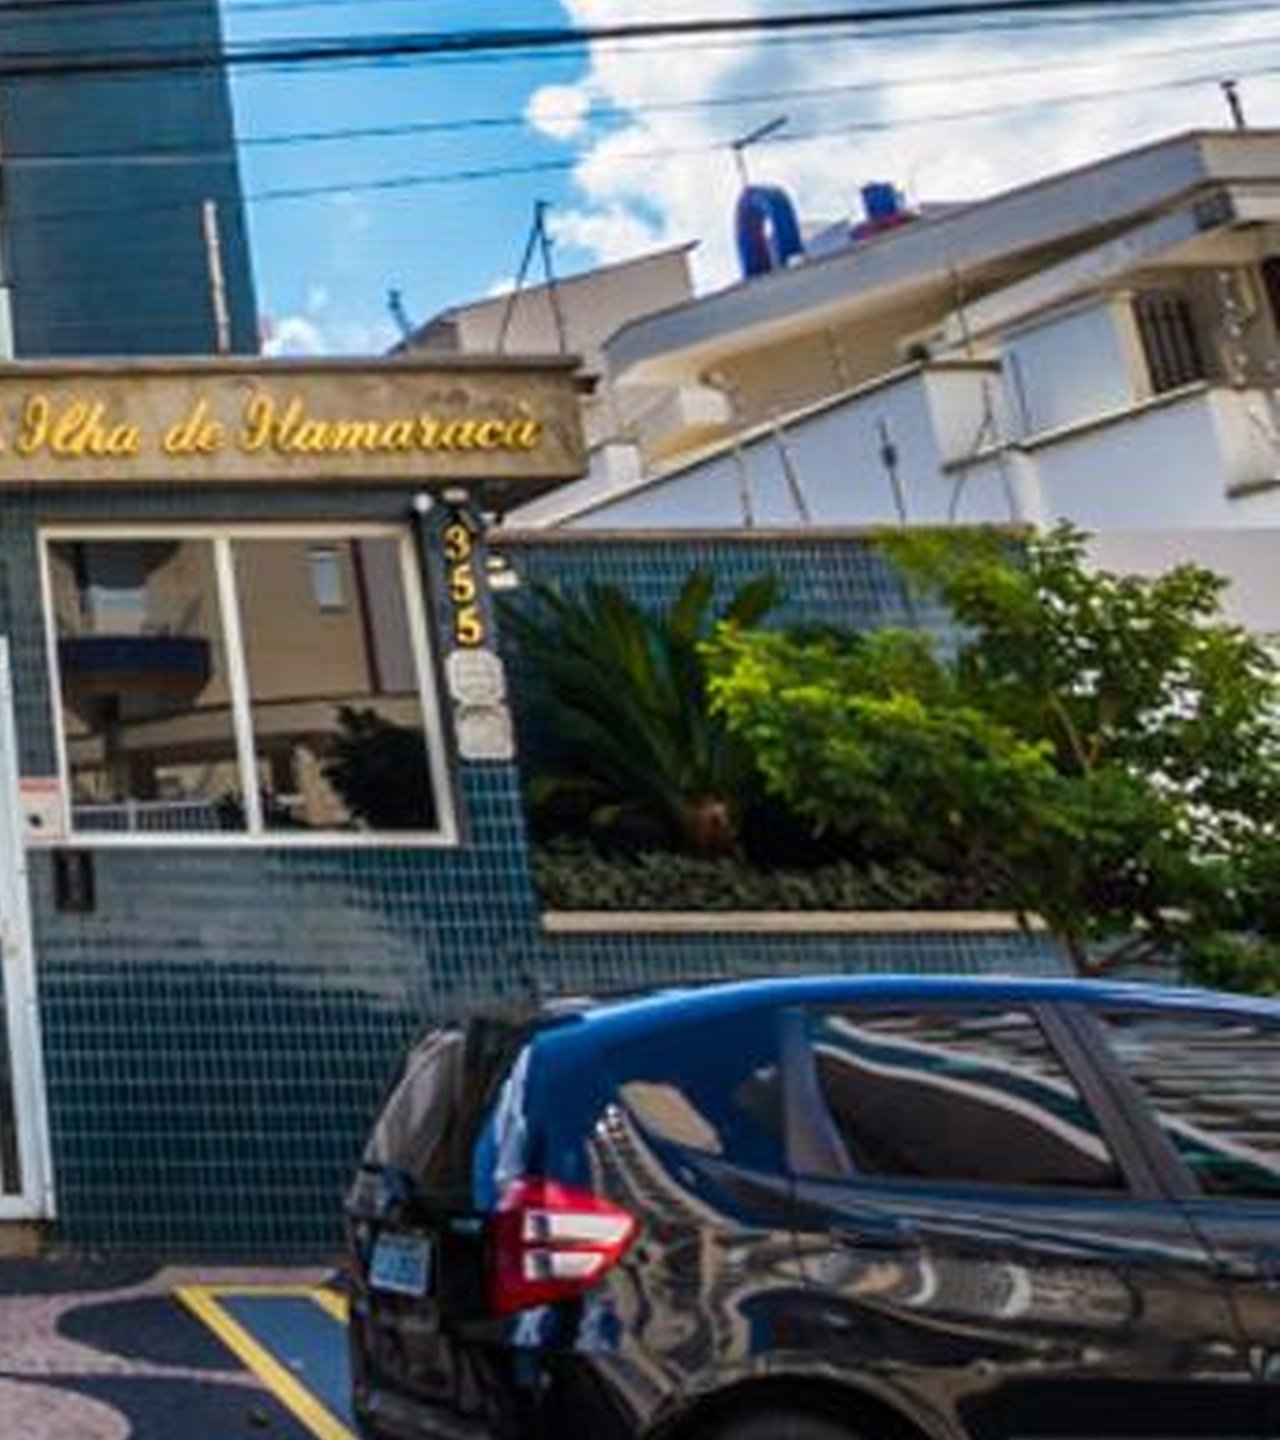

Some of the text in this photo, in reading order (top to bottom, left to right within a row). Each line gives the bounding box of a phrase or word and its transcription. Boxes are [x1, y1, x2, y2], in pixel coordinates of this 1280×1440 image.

[17, 392, 140, 457] Ilha
[163, 397, 225, 454] de
[443, 523, 483, 645] 355
